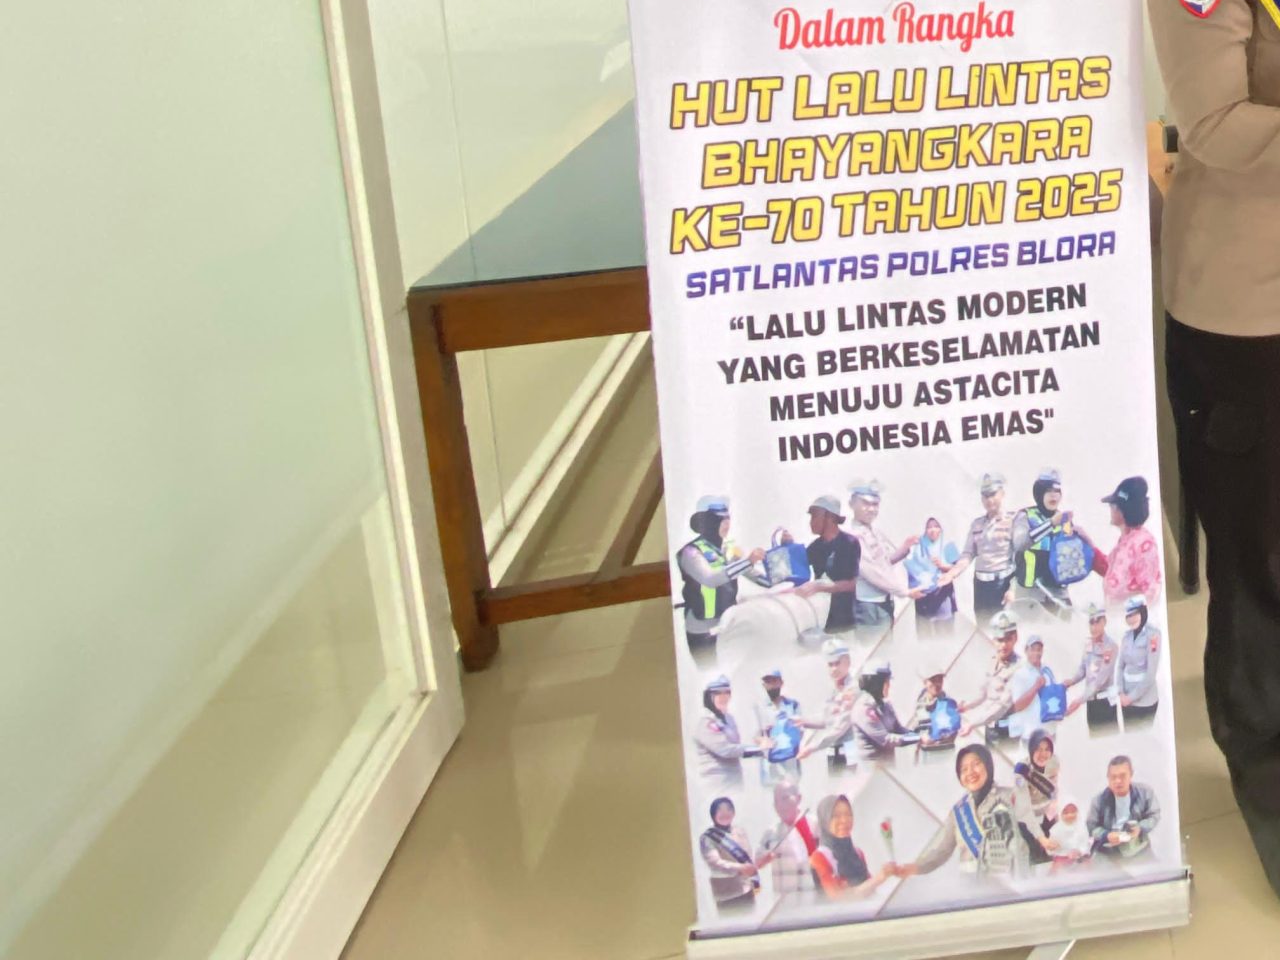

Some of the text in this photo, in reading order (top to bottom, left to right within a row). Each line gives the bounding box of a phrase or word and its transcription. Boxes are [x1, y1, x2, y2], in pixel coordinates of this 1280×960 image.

[773, 1, 1016, 53] Dalam Rangka
[668, 55, 1112, 130] HUT LALU LINTAS
[700, 114, 1093, 190] BHAYANGKARA
[669, 168, 1124, 255] KE-70 TAHUN 2025
[685, 230, 1117, 299] SATLANTAS POLRES BLORA
[837, 298, 947, 333] LINTAS
[956, 282, 1087, 321] MODERN
[717, 320, 1100, 385] YANG BERKESELAMATAN
[769, 367, 1060, 422] MENUJU ASTACITA
[778, 407, 1054, 462] INDONESIA EMAS"
